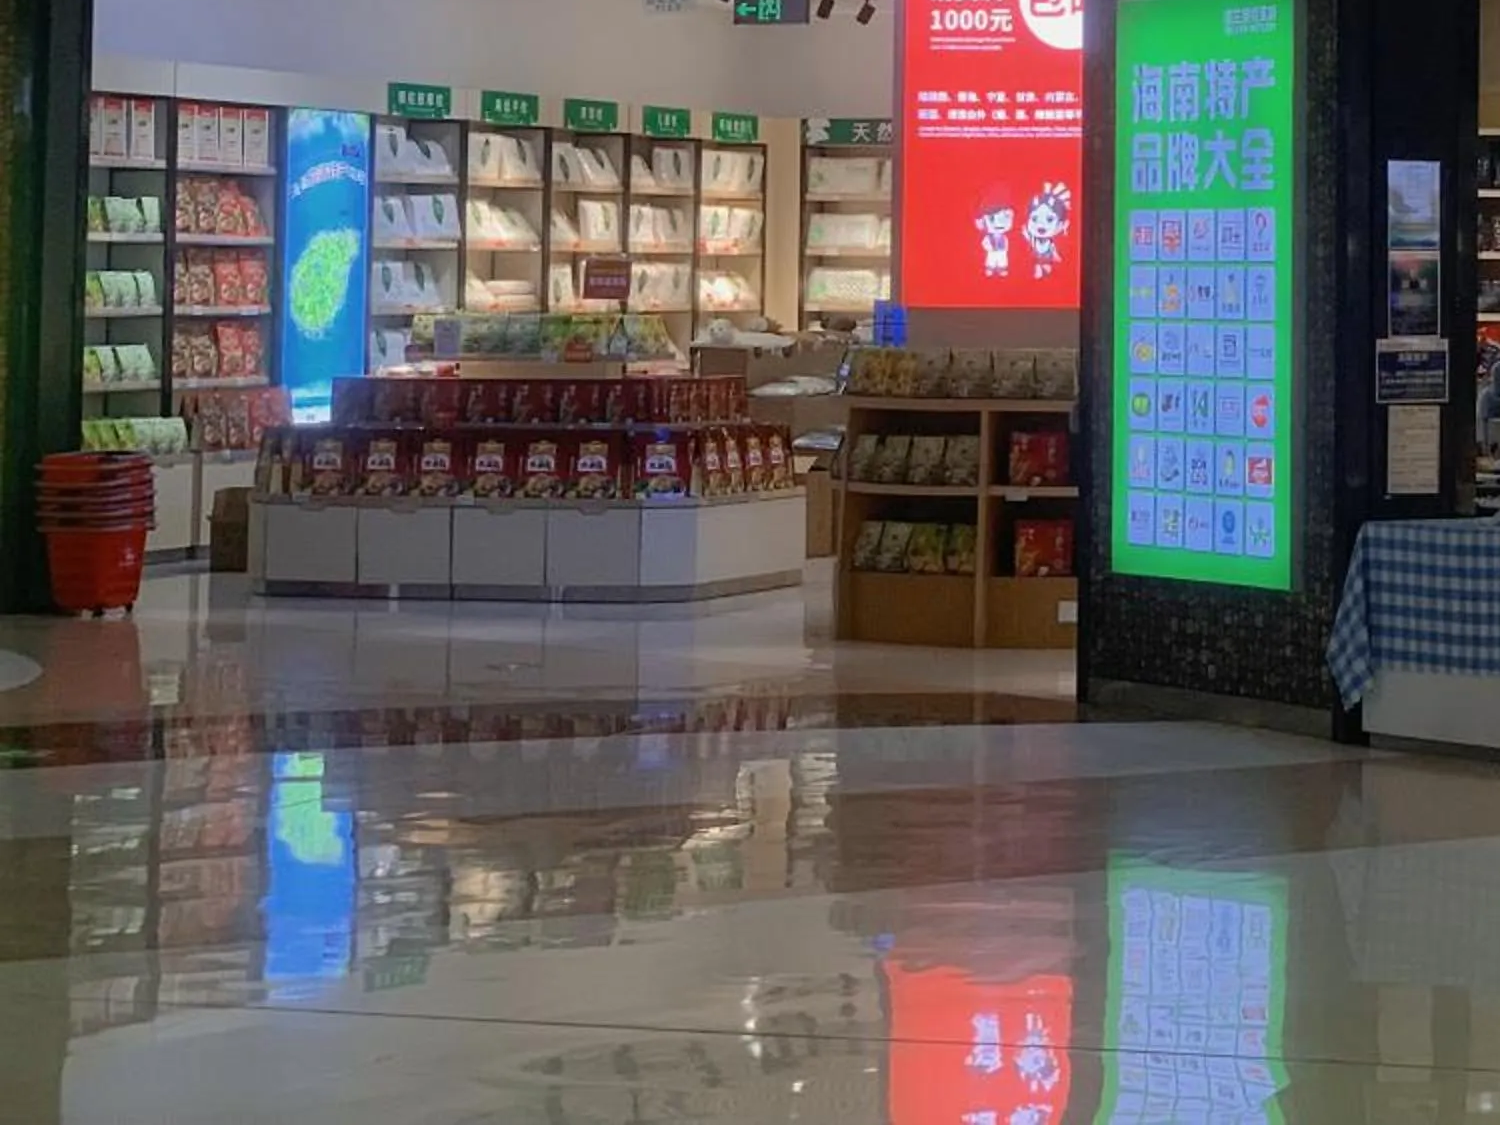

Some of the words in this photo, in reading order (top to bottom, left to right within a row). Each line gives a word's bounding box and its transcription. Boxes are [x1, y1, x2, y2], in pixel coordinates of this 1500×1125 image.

[929, 8, 1013, 32] 1000元
[1131, 55, 1276, 123] 海南特产
[1131, 128, 1275, 193] 品牌大全
